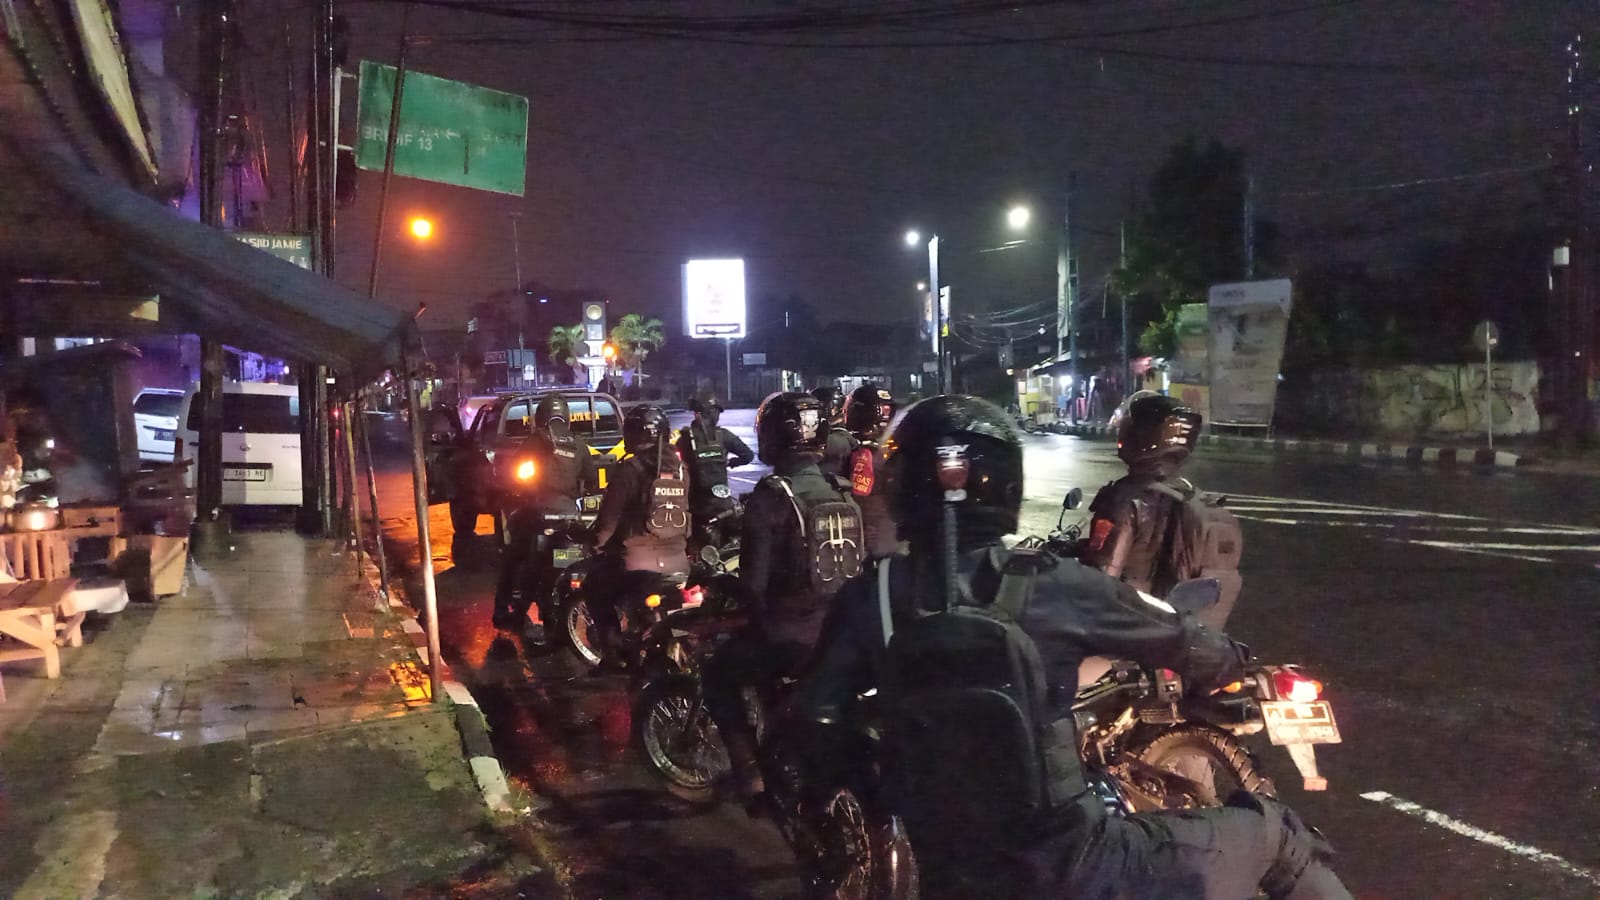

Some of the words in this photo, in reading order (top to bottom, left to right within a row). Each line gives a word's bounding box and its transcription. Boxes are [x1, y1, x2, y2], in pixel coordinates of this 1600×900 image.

[363, 126, 413, 146] BRIIF
[417, 137, 433, 151] 13
[237, 237, 270, 249] ASJID
[271, 239, 302, 250] JAMIE
[655, 487, 684, 496] POLISI
[819, 516, 854, 530] POLSI
